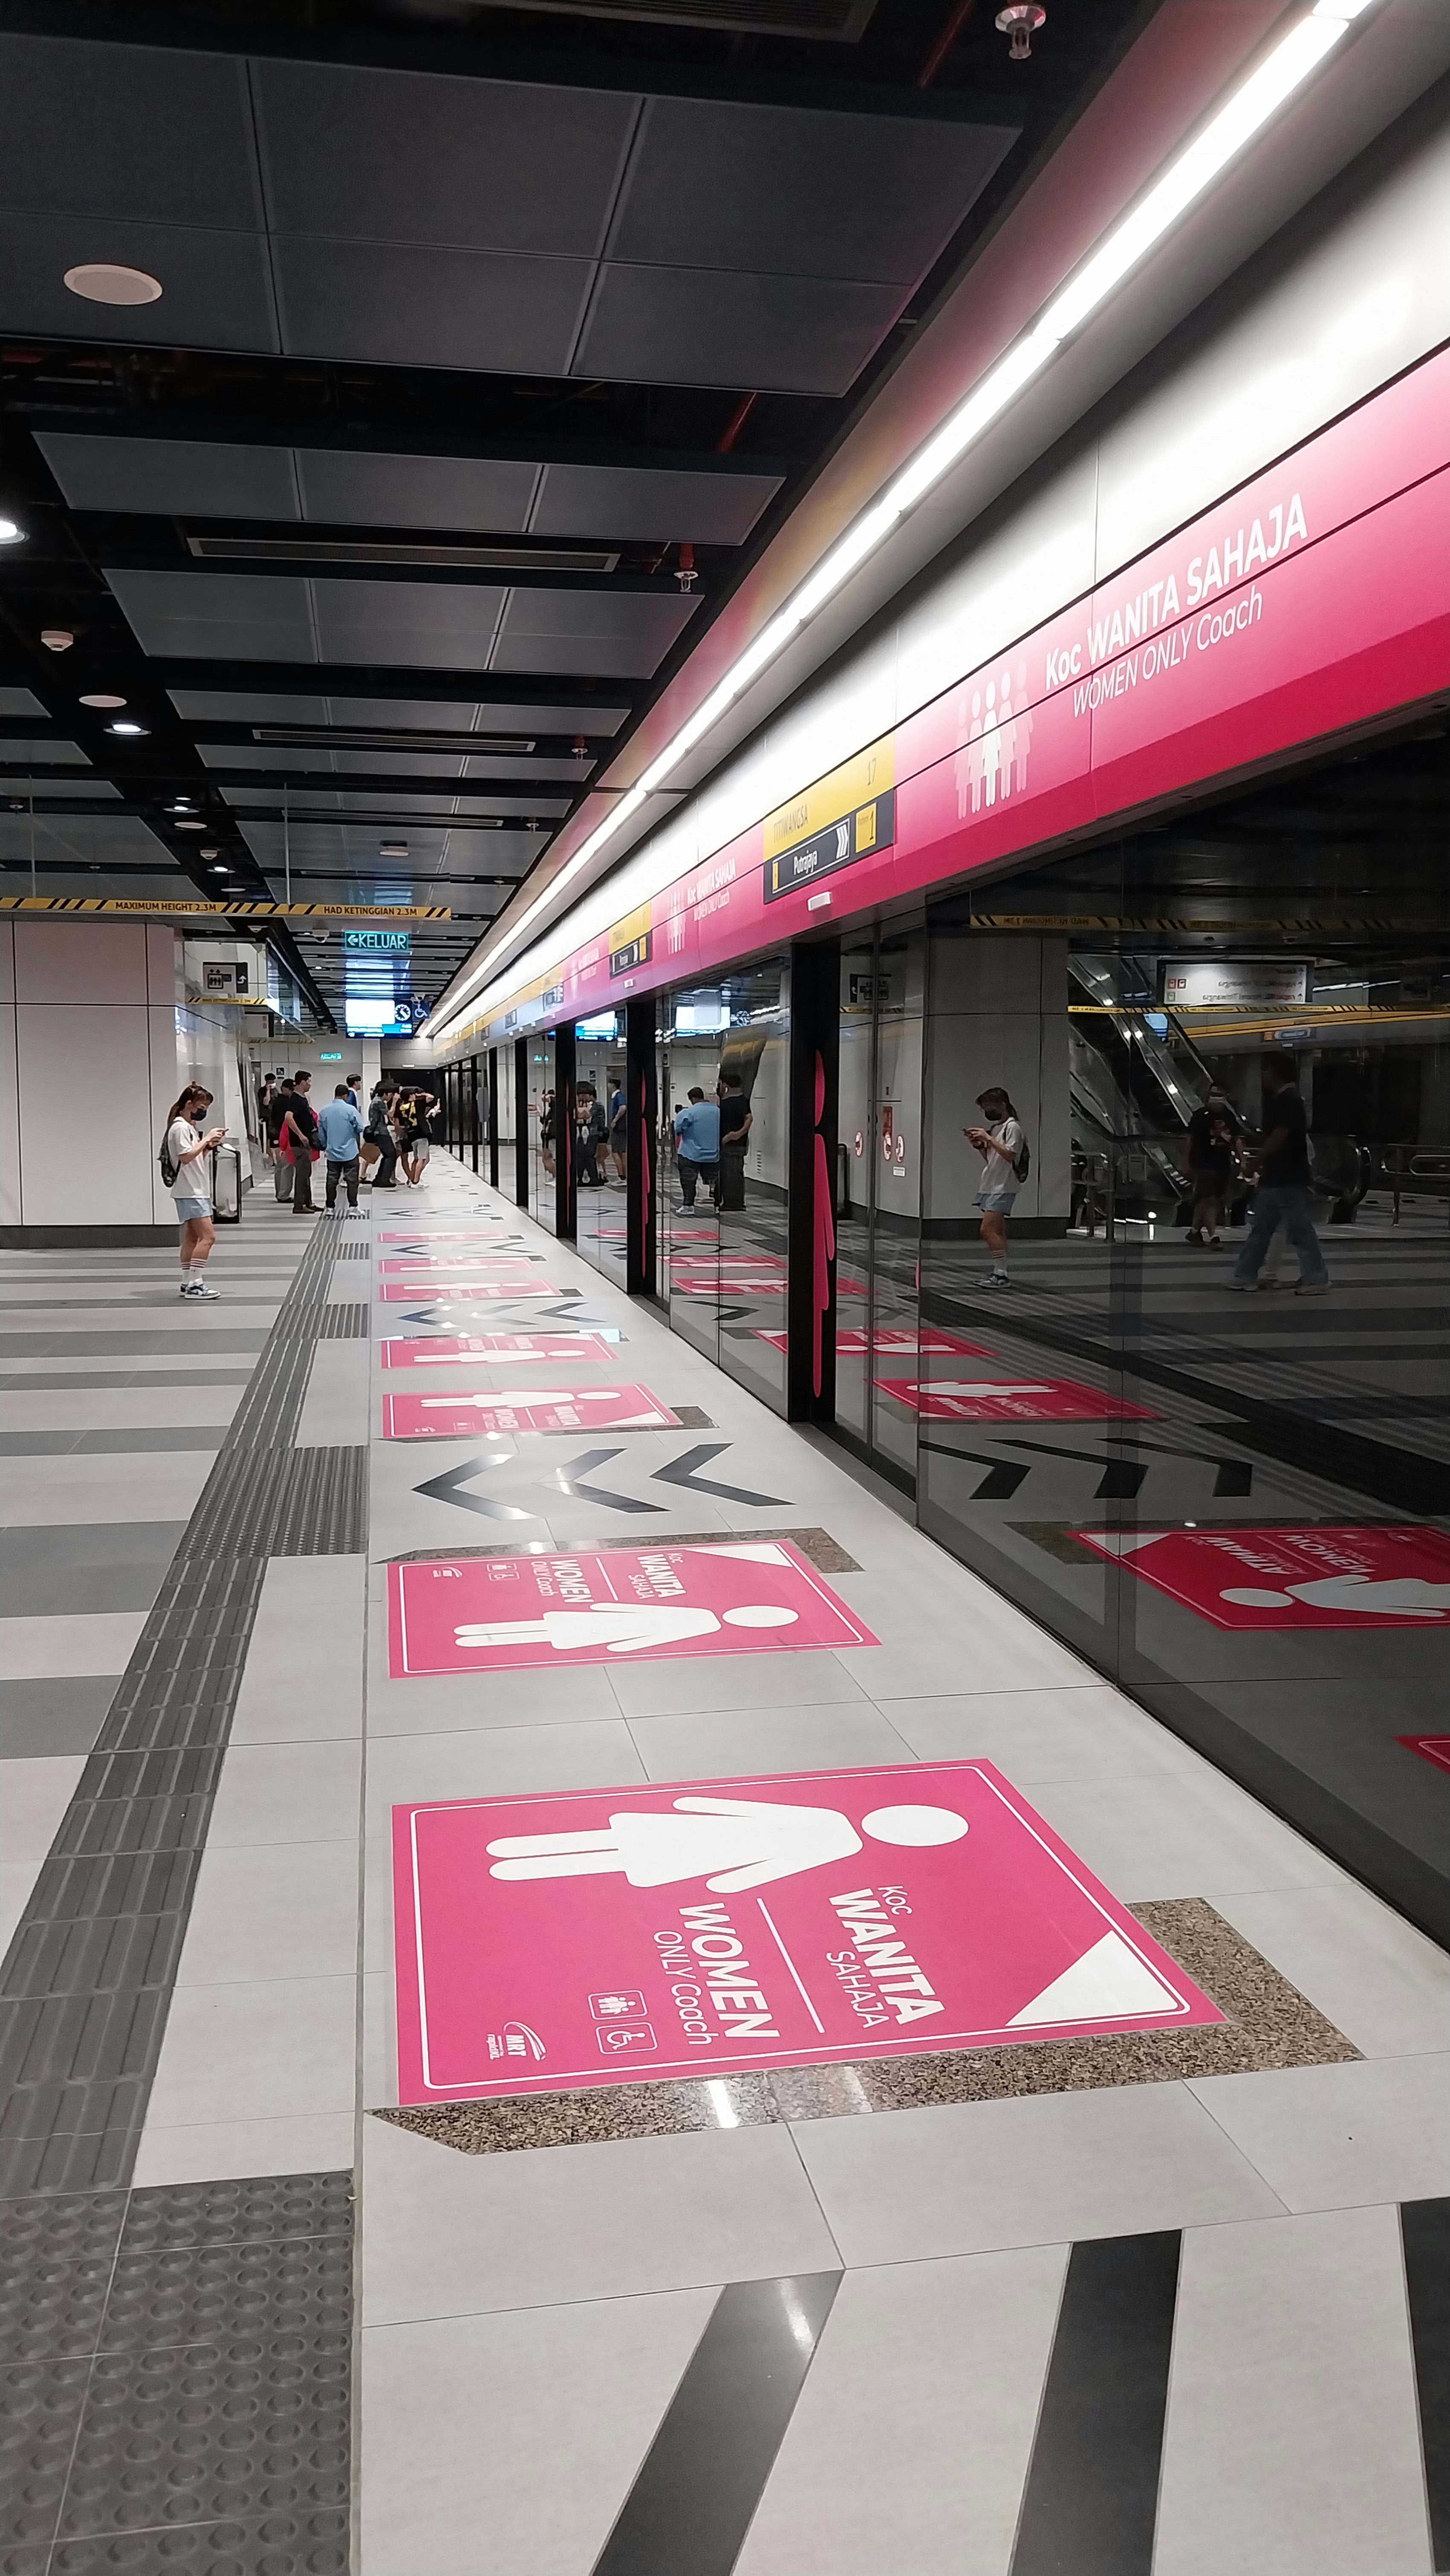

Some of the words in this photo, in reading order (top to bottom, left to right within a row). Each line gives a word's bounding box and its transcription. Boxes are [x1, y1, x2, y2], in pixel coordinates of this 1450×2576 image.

[1046, 643, 1082, 691] Koc
[1087, 574, 1180, 665] WANITA
[1186, 492, 1308, 606] SAHAJA
[1073, 660, 1138, 718] WOMEN
[1142, 622, 1194, 681] ONLY
[1196, 585, 1262, 651] Coach
[793, 849, 818, 876] Putrajaya
[115, 901, 159, 911] MAXIMUM
[161, 903, 194, 912] HEIGHT
[195, 903, 217, 912] 2.3M
[324, 906, 342, 914] HAD
[344, 906, 395, 915] KETINGGIAN
[396, 908, 417, 916] 2.3M
[358, 934, 406, 949] KELUAR
[530, 1561, 550, 1581] ONLY
[535, 1577, 558, 1596] Coach
[550, 1559, 595, 1603] WOMEN
[628, 1574, 655, 1600] SAHAJA
[637, 1554, 687, 1598] WANITA
[877, 1885, 913, 1916] Koc
[653, 1930, 697, 1980] ONLY
[679, 1902, 780, 2038] WOMEN
[828, 1888, 945, 2025] WANITA
[826, 1951, 890, 2029] SAHAJA
[670, 1983, 719, 2045] Coach
[505, 2034, 527, 2057] MRT
